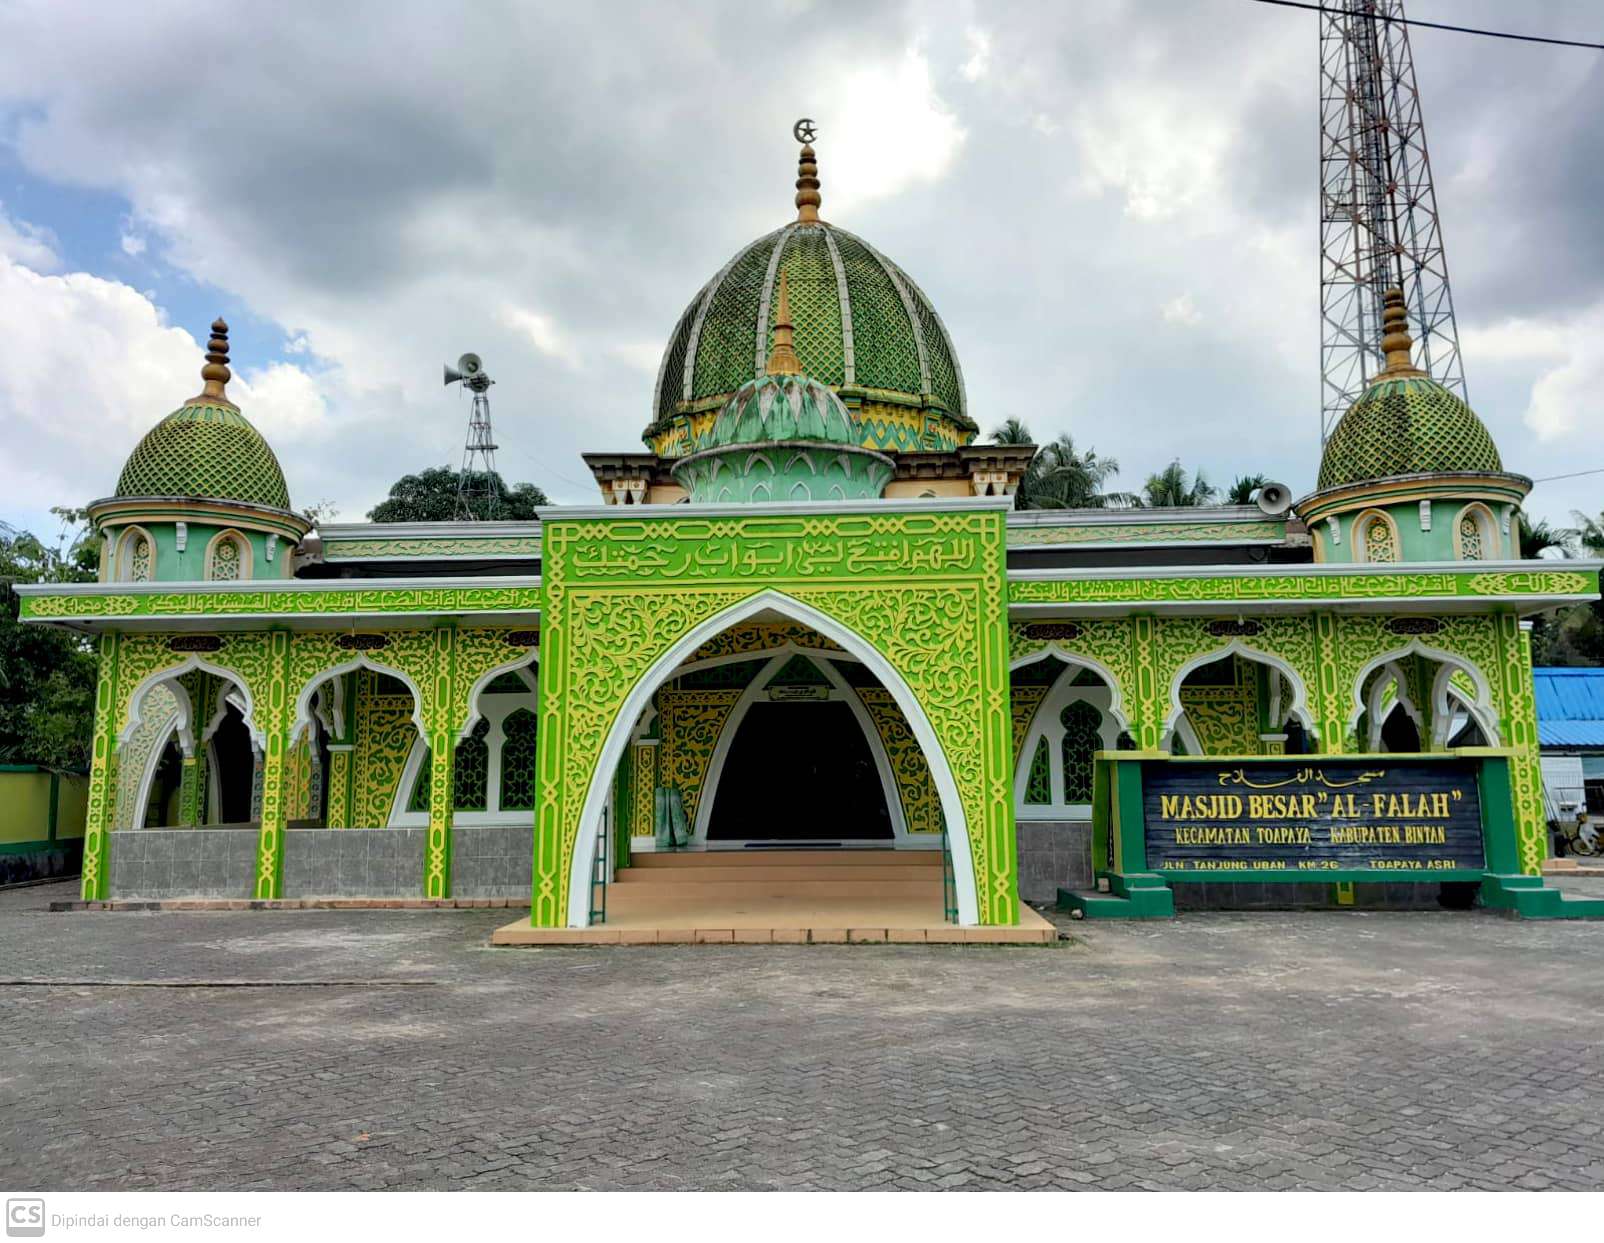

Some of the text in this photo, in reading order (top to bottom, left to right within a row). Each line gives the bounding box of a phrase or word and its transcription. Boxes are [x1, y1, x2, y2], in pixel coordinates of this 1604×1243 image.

[1161, 795, 1243, 819] MASJID
[1175, 826, 1445, 844] KECAMATAN TOAPAYA KABUPATEN BINTAN
[1163, 861, 1184, 870] JLN
[1193, 860, 1248, 870] TANJUNG
[1253, 860, 1286, 870] UBAN
[1370, 860, 1422, 870] TOAPAYA
[1427, 860, 1456, 870] ASRI
